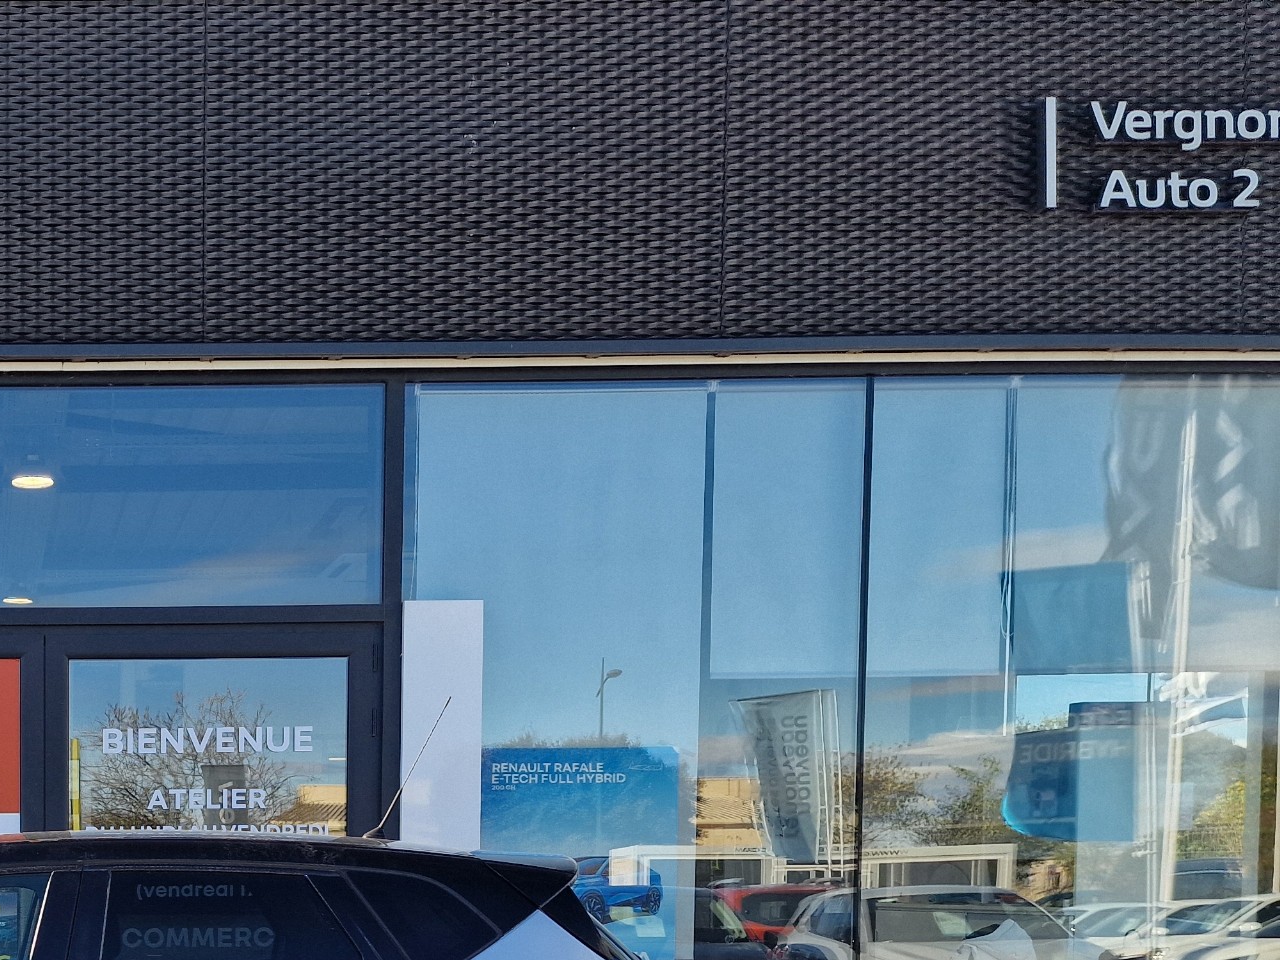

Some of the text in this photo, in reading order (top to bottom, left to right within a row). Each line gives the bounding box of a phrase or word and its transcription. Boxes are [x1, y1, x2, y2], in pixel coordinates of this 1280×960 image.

[1100, 169, 1260, 208] Auto 2
[102, 726, 313, 754] BIENVENUE
[491, 773, 626, 784] E-TECH FULL HYBRID
[492, 763, 604, 773] RENAULT RAFALE
[147, 788, 267, 810] ATELIER
